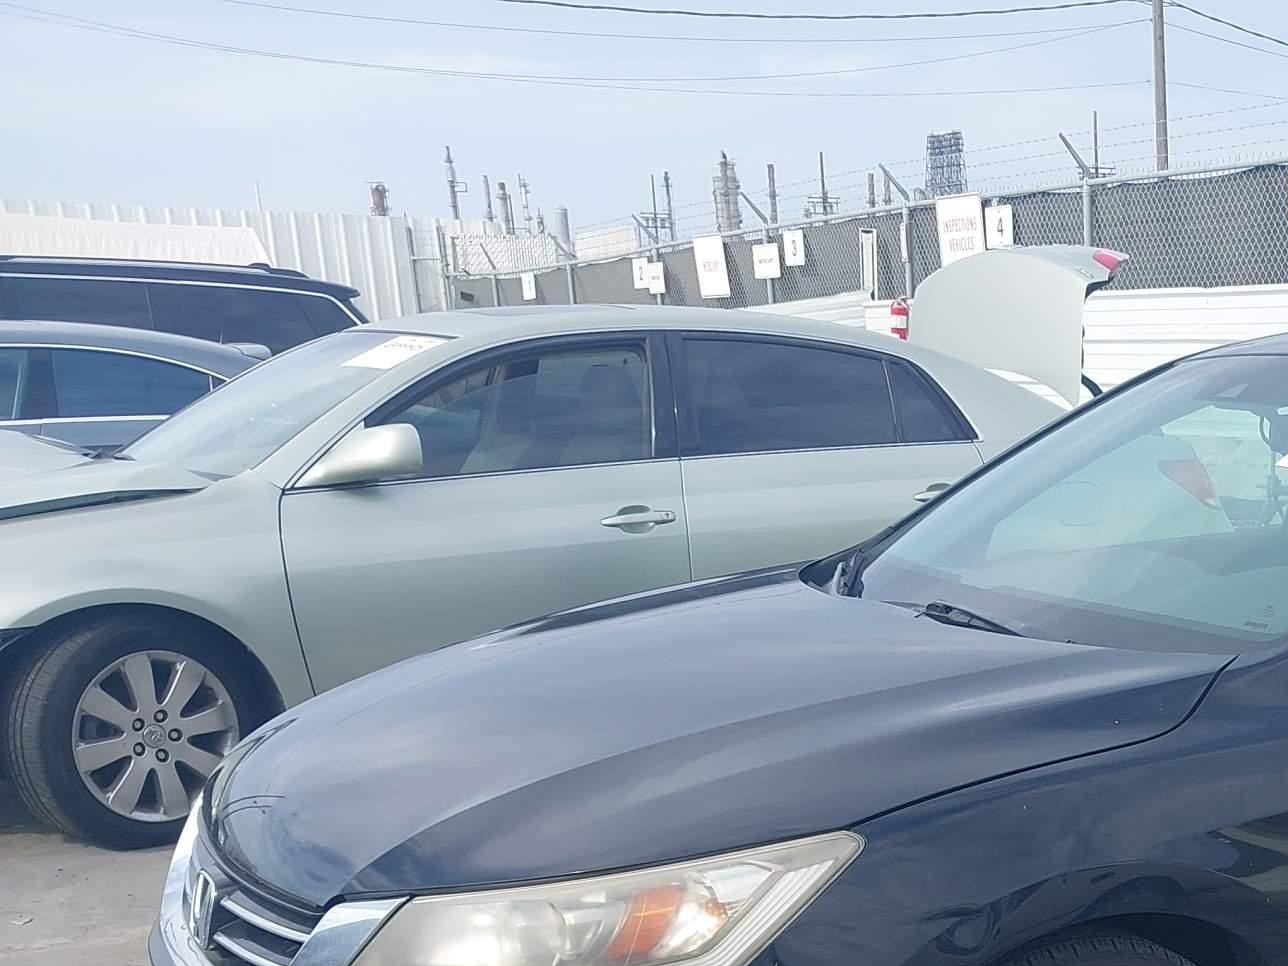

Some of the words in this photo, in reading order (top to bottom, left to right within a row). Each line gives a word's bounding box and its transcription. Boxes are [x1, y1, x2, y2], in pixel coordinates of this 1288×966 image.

[942, 215, 977, 233] INSPECTIONS
[997, 216, 1004, 237] 4
[791, 239, 798, 257] 3
[948, 236, 975, 252] VEHICLES
[638, 265, 644, 281] 2
